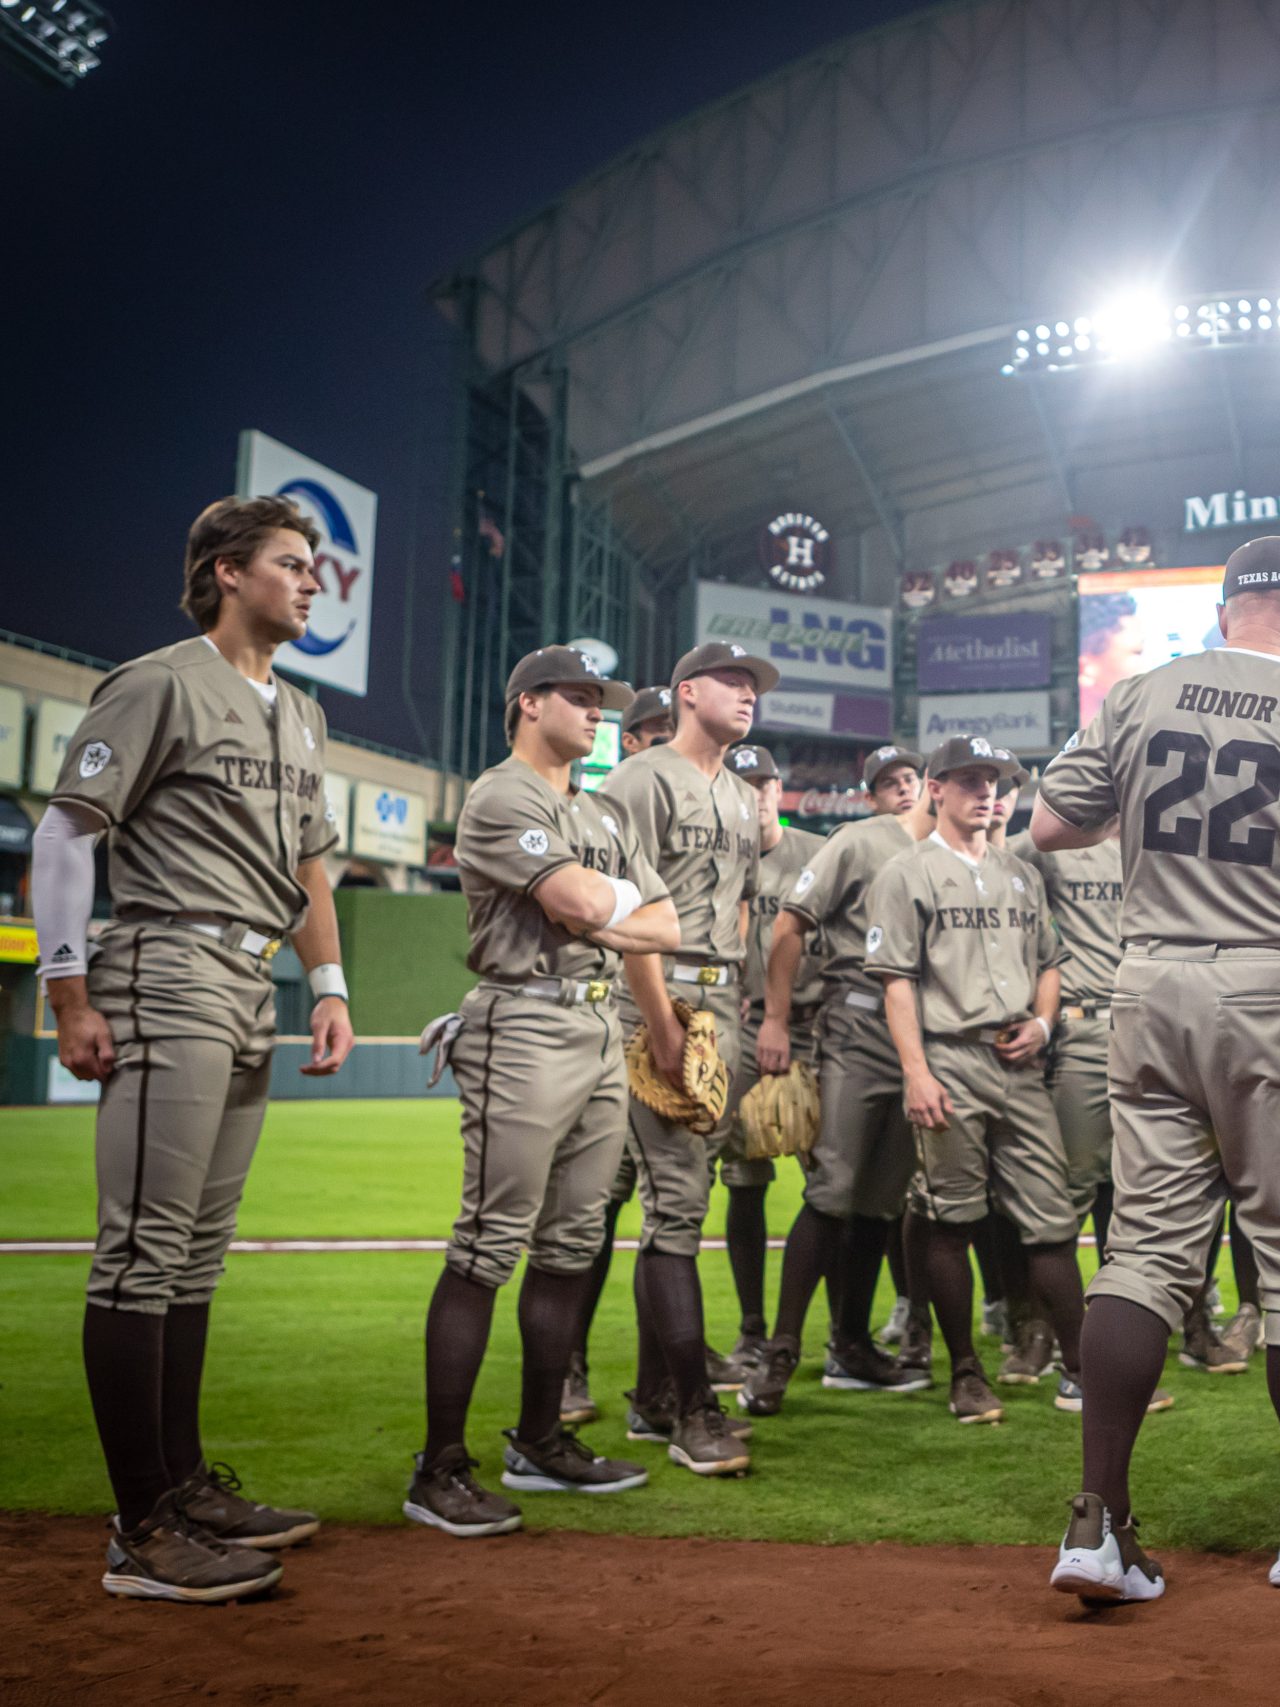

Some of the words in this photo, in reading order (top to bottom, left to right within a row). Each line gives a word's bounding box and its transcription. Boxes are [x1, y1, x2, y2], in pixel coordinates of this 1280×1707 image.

[787, 536, 814, 566] H
[1238, 571, 1269, 585] TEXAS
[770, 608, 887, 671] LNG
[1176, 683, 1279, 723] HONOR
[1067, 881, 1123, 901] TEXA
[936, 907, 1001, 931] TEXAS
